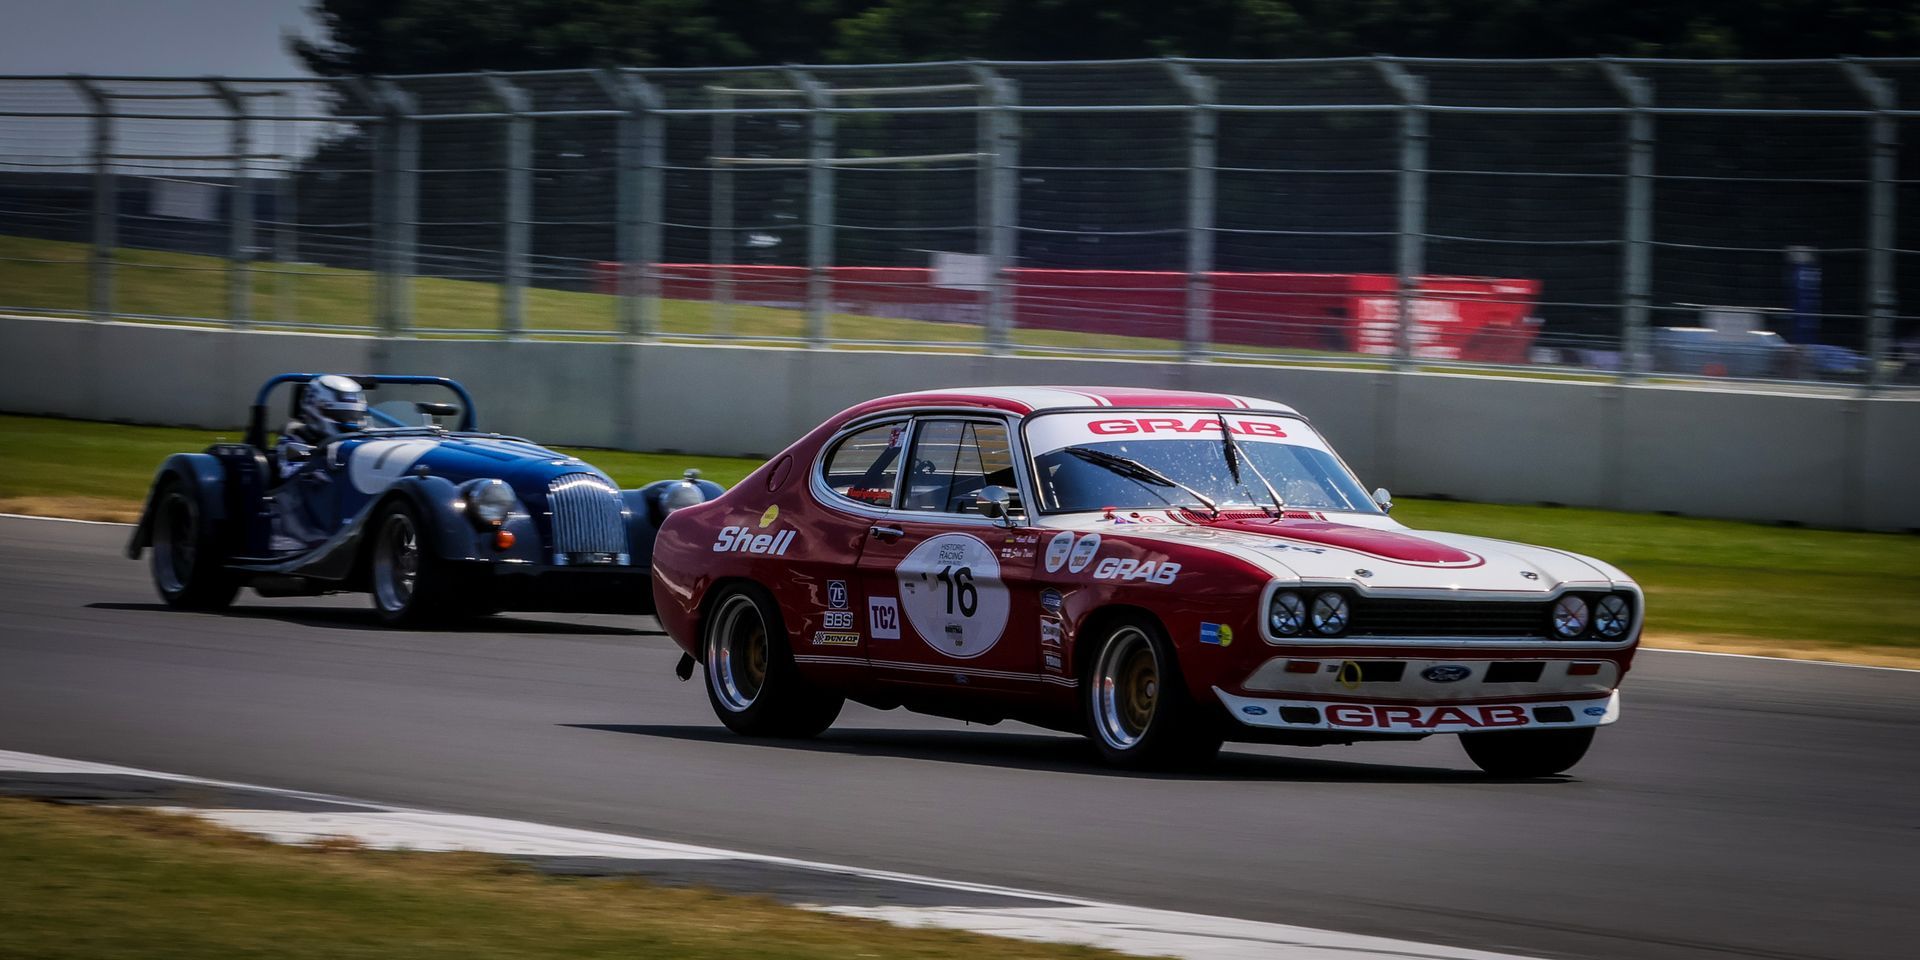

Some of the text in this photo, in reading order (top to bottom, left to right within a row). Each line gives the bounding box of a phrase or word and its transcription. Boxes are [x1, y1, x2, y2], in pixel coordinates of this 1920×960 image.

[1087, 418, 1288, 438] GRAB
[713, 526, 796, 555] Shell
[941, 543, 966, 551] HISTORIC
[939, 550, 963, 560] RACING
[1093, 557, 1182, 585] GRAB
[830, 588, 845, 602] ZF
[937, 565, 978, 617] 16
[825, 613, 852, 628] BBS
[871, 605, 897, 630] TC2
[824, 634, 858, 643] DUNLOP
[1325, 705, 1531, 728] GRAB
